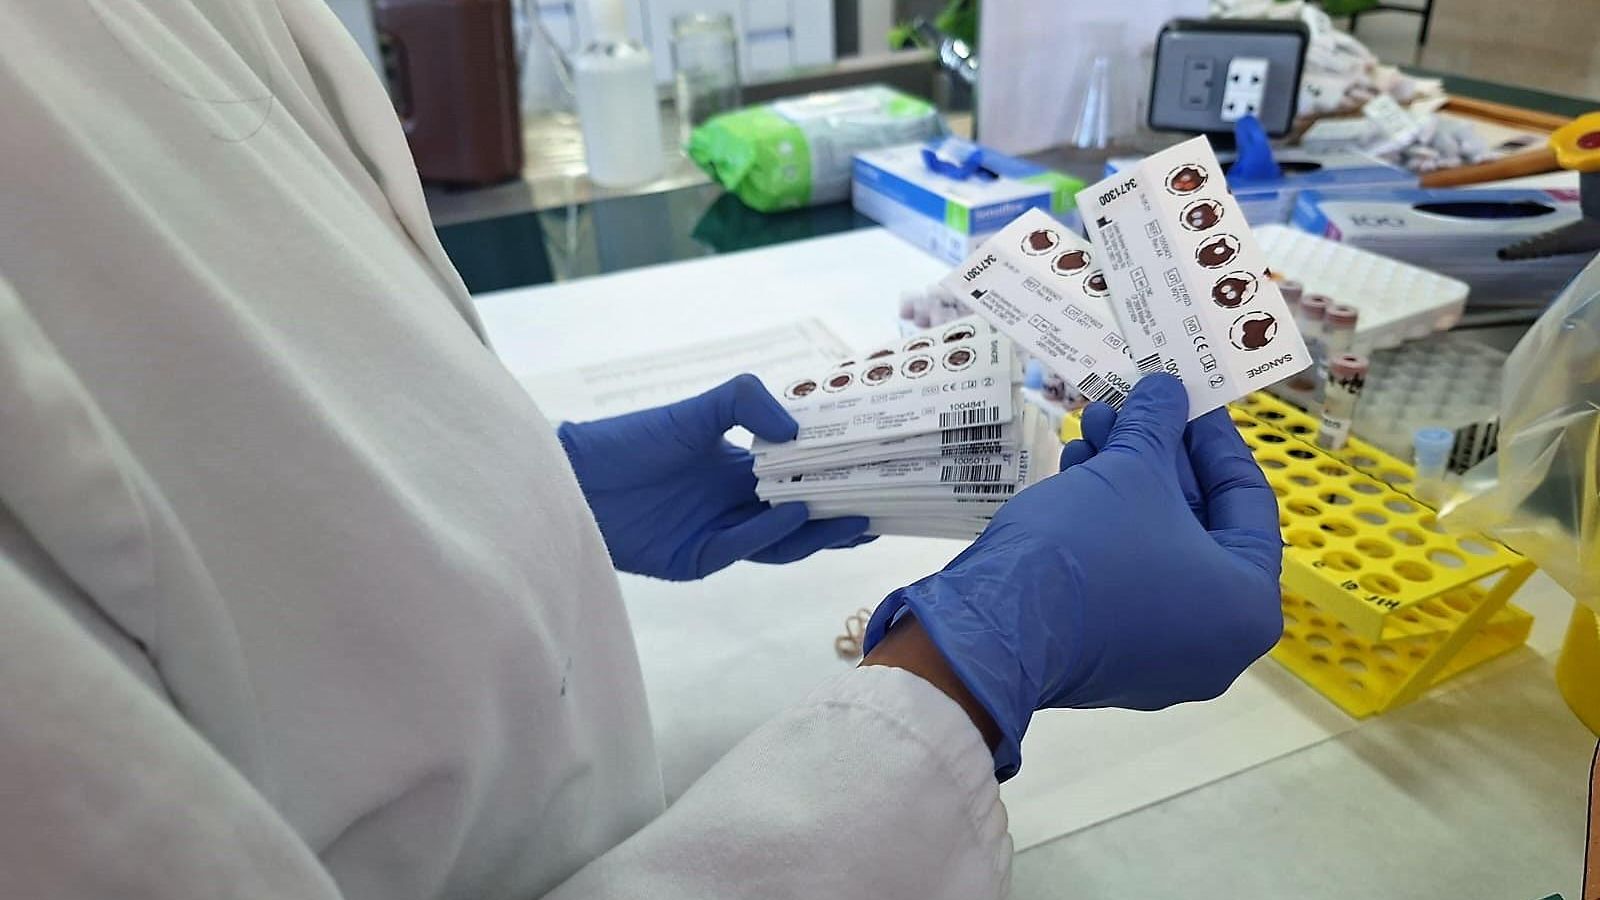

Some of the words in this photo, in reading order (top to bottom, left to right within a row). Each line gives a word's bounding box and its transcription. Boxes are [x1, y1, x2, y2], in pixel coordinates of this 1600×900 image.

[1098, 178, 1137, 206] 3471300
[963, 253, 998, 282] 3471301
[1247, 353, 1293, 379] SANGRE
[1103, 371, 1131, 393] 10048
